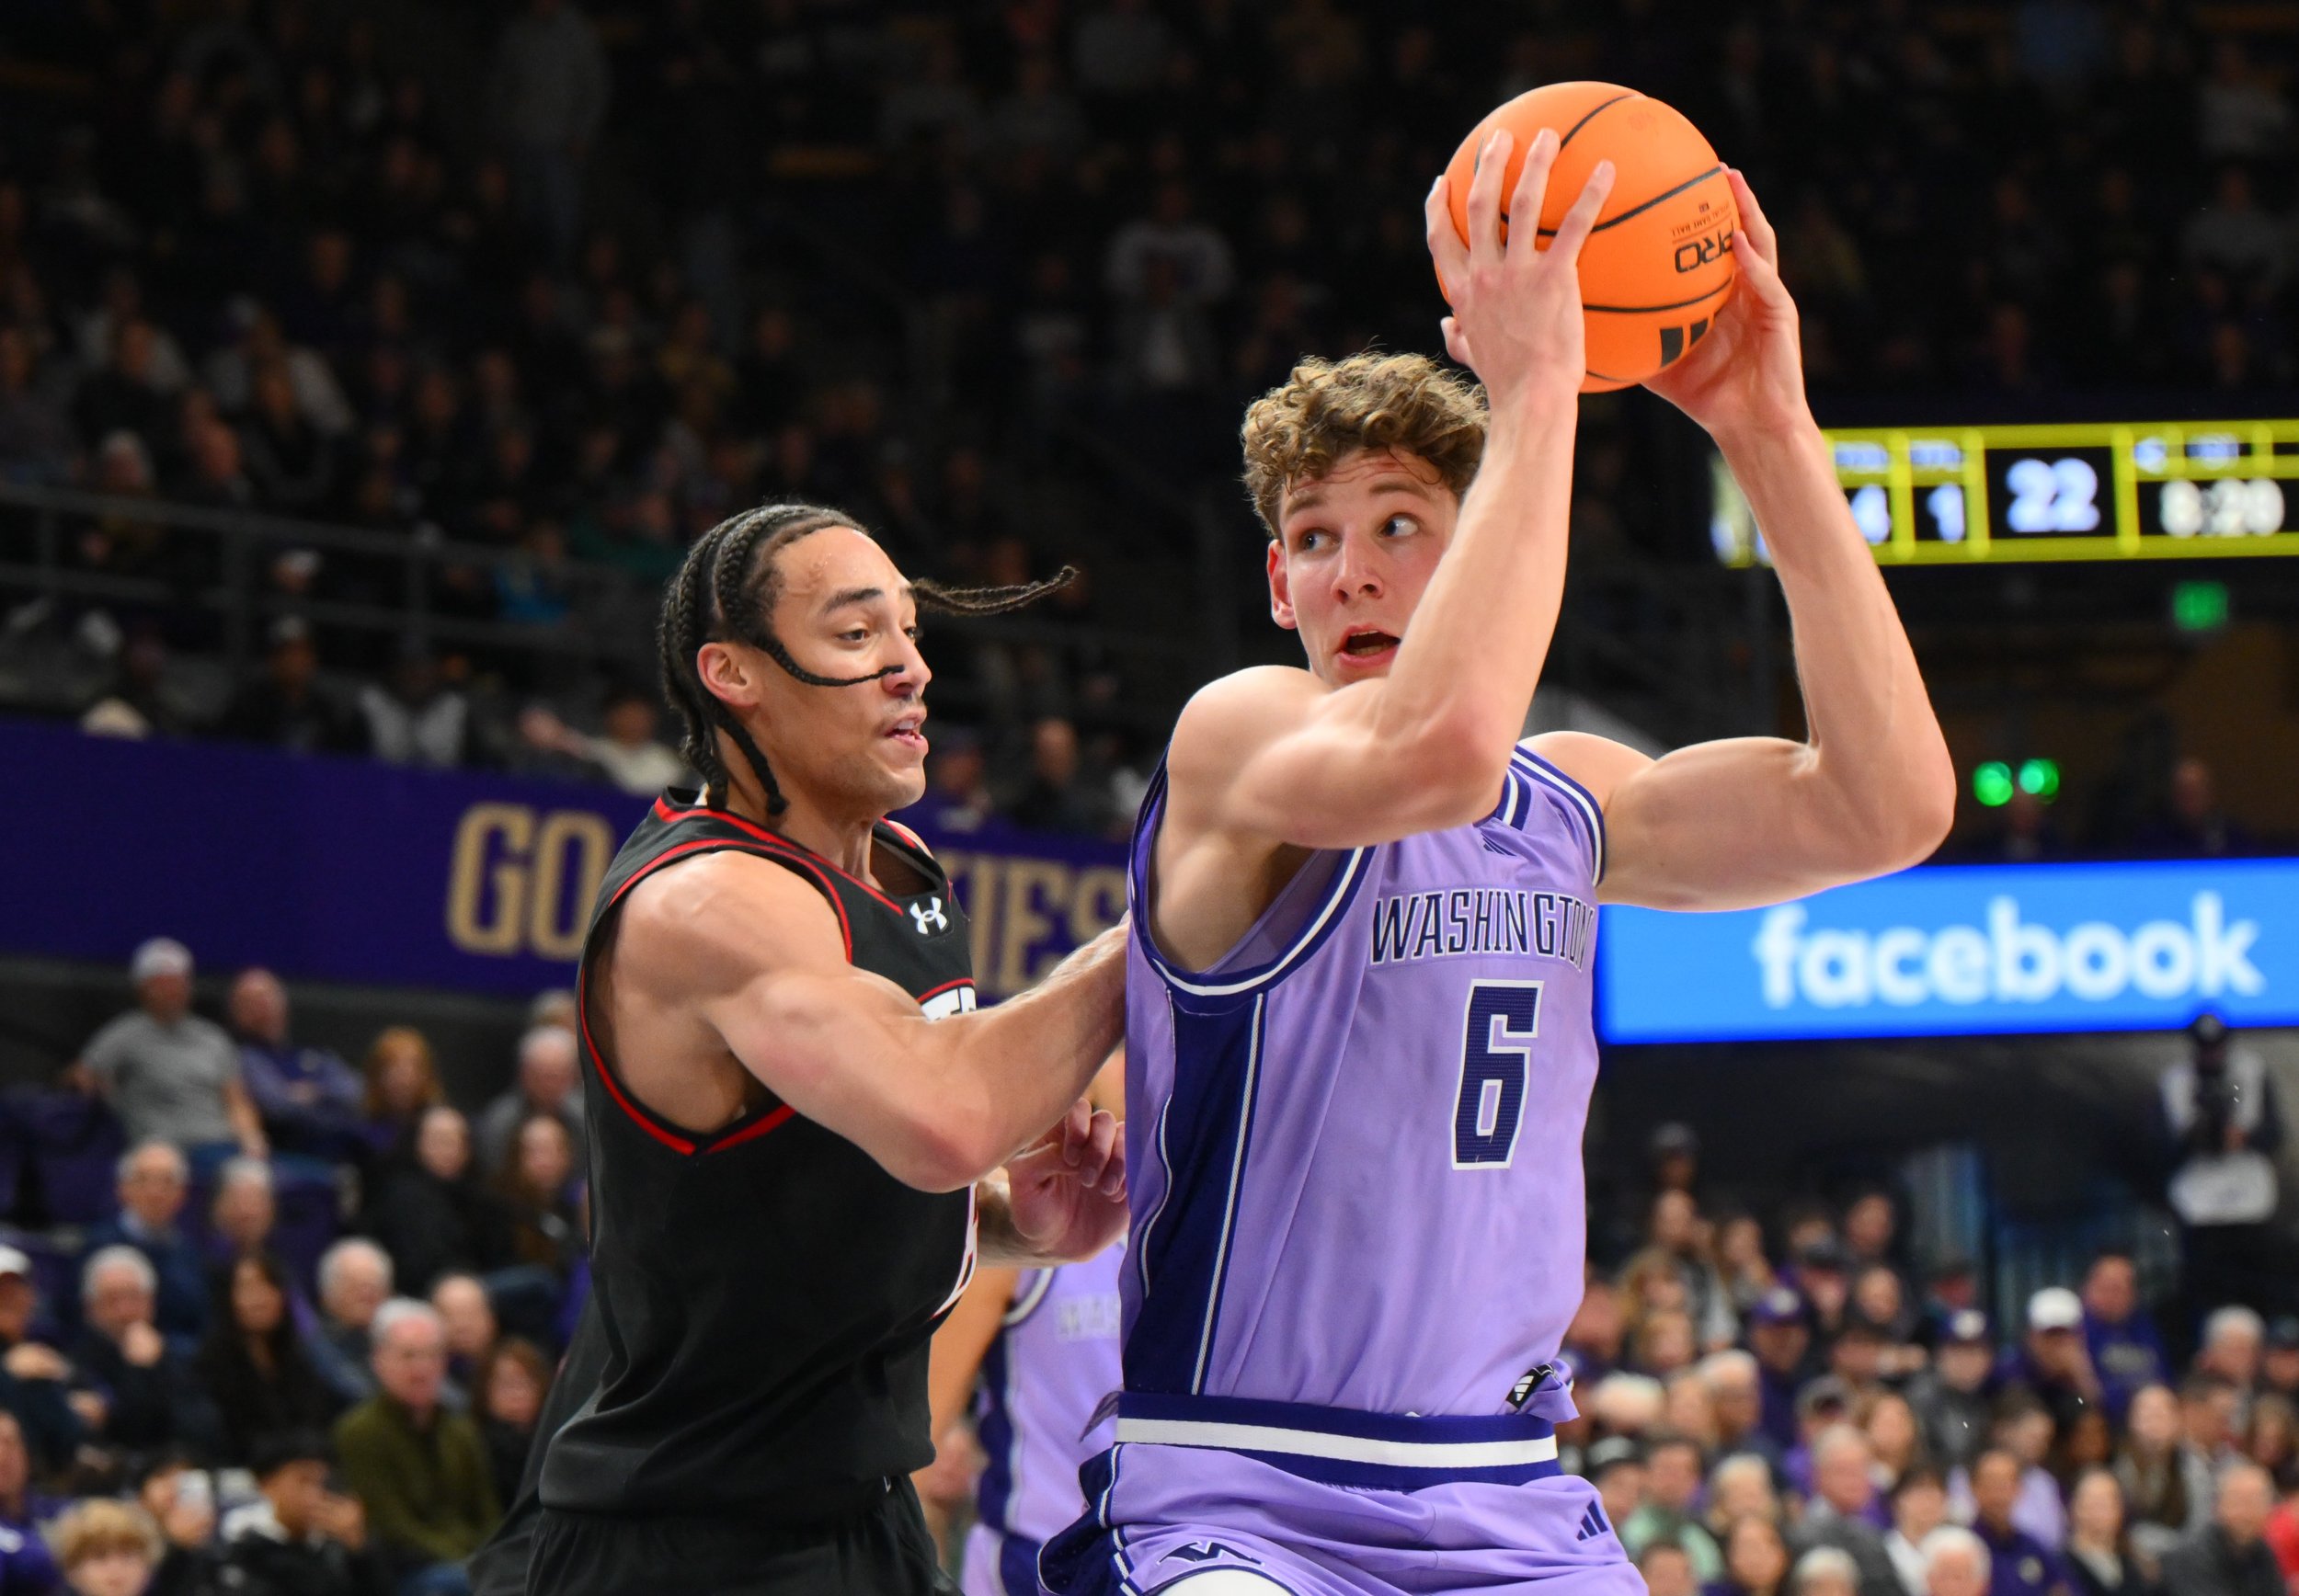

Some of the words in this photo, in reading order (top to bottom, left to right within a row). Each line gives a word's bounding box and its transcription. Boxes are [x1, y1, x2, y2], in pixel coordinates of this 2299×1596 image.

[1675, 220, 1734, 273] PRO
[1927, 482, 1966, 544] 1
[2005, 458, 2100, 533] 22
[447, 802, 614, 962] GO
[1369, 887, 1596, 973] WASHINGTON
[1752, 888, 2265, 1009] facebook
[1451, 978, 1545, 1170] 6
